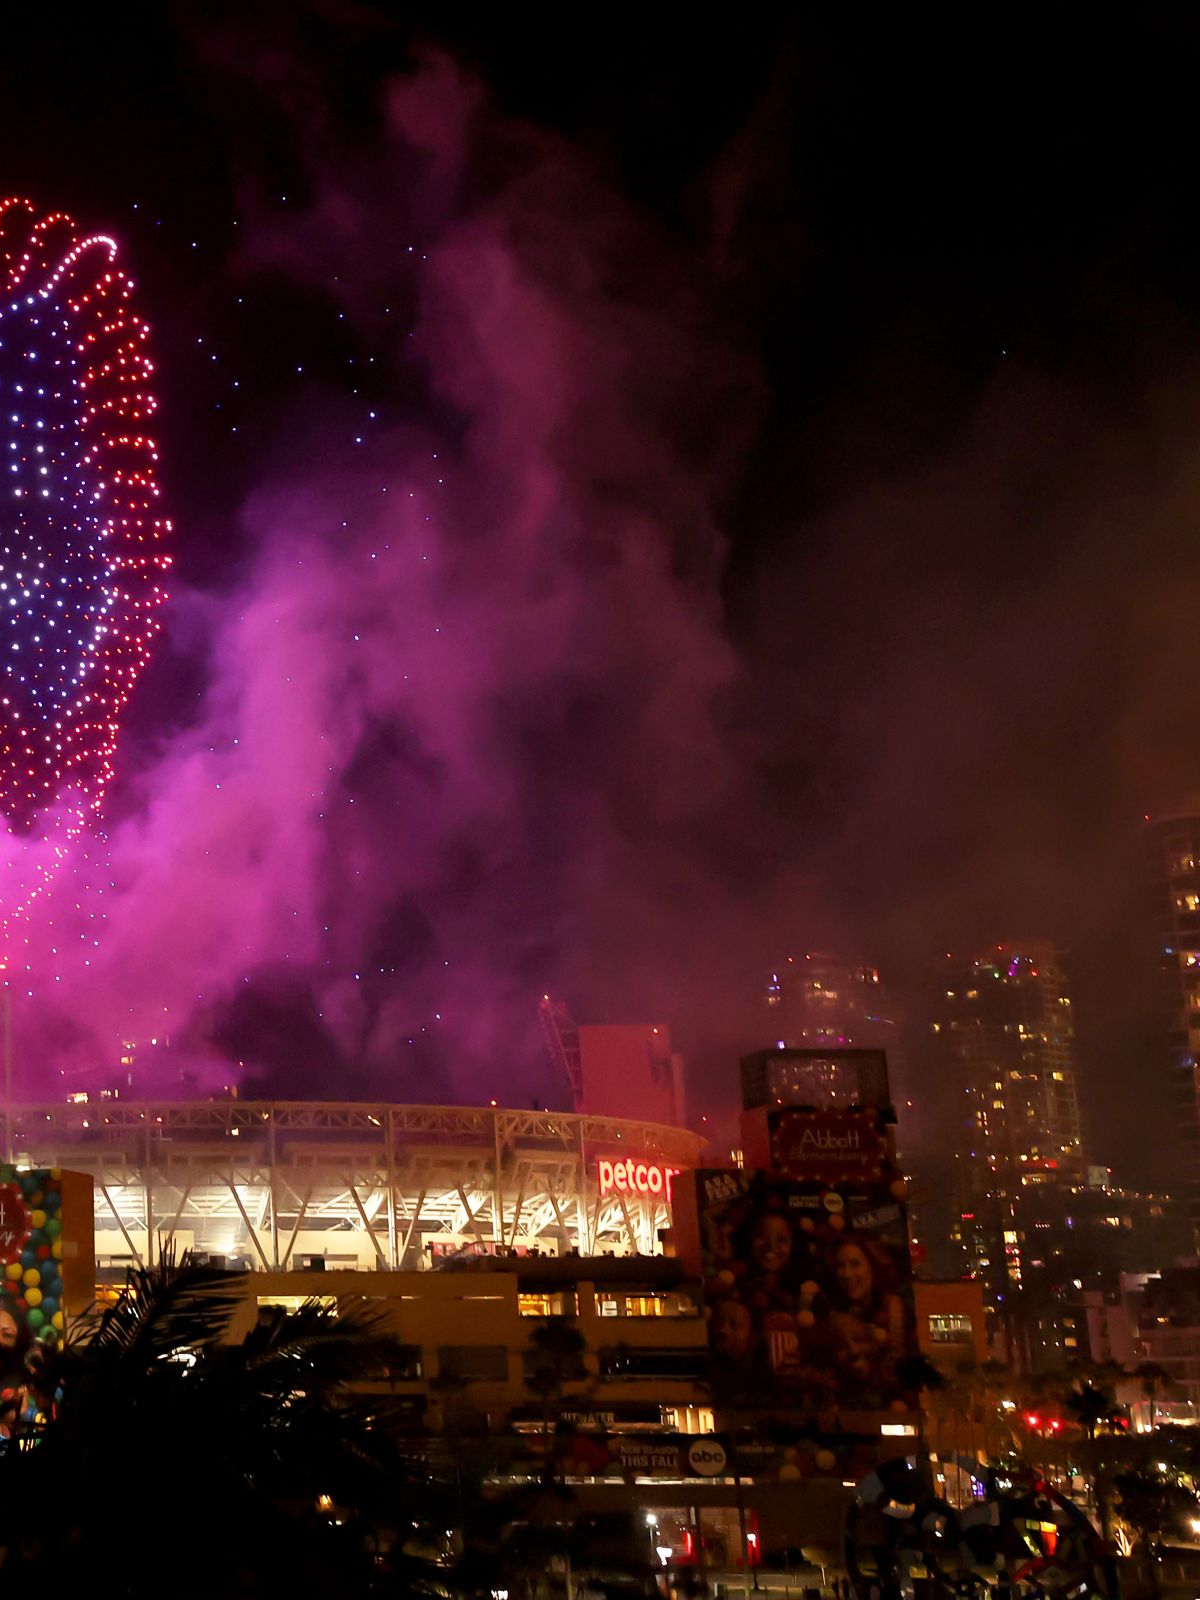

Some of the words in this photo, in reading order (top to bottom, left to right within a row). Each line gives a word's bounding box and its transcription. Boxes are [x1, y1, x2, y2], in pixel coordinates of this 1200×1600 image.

[800, 1128, 860, 1151] Abbott
[598, 1158, 662, 1196] petco
[620, 1455, 649, 1468] THIS
[651, 1455, 679, 1468] FALL
